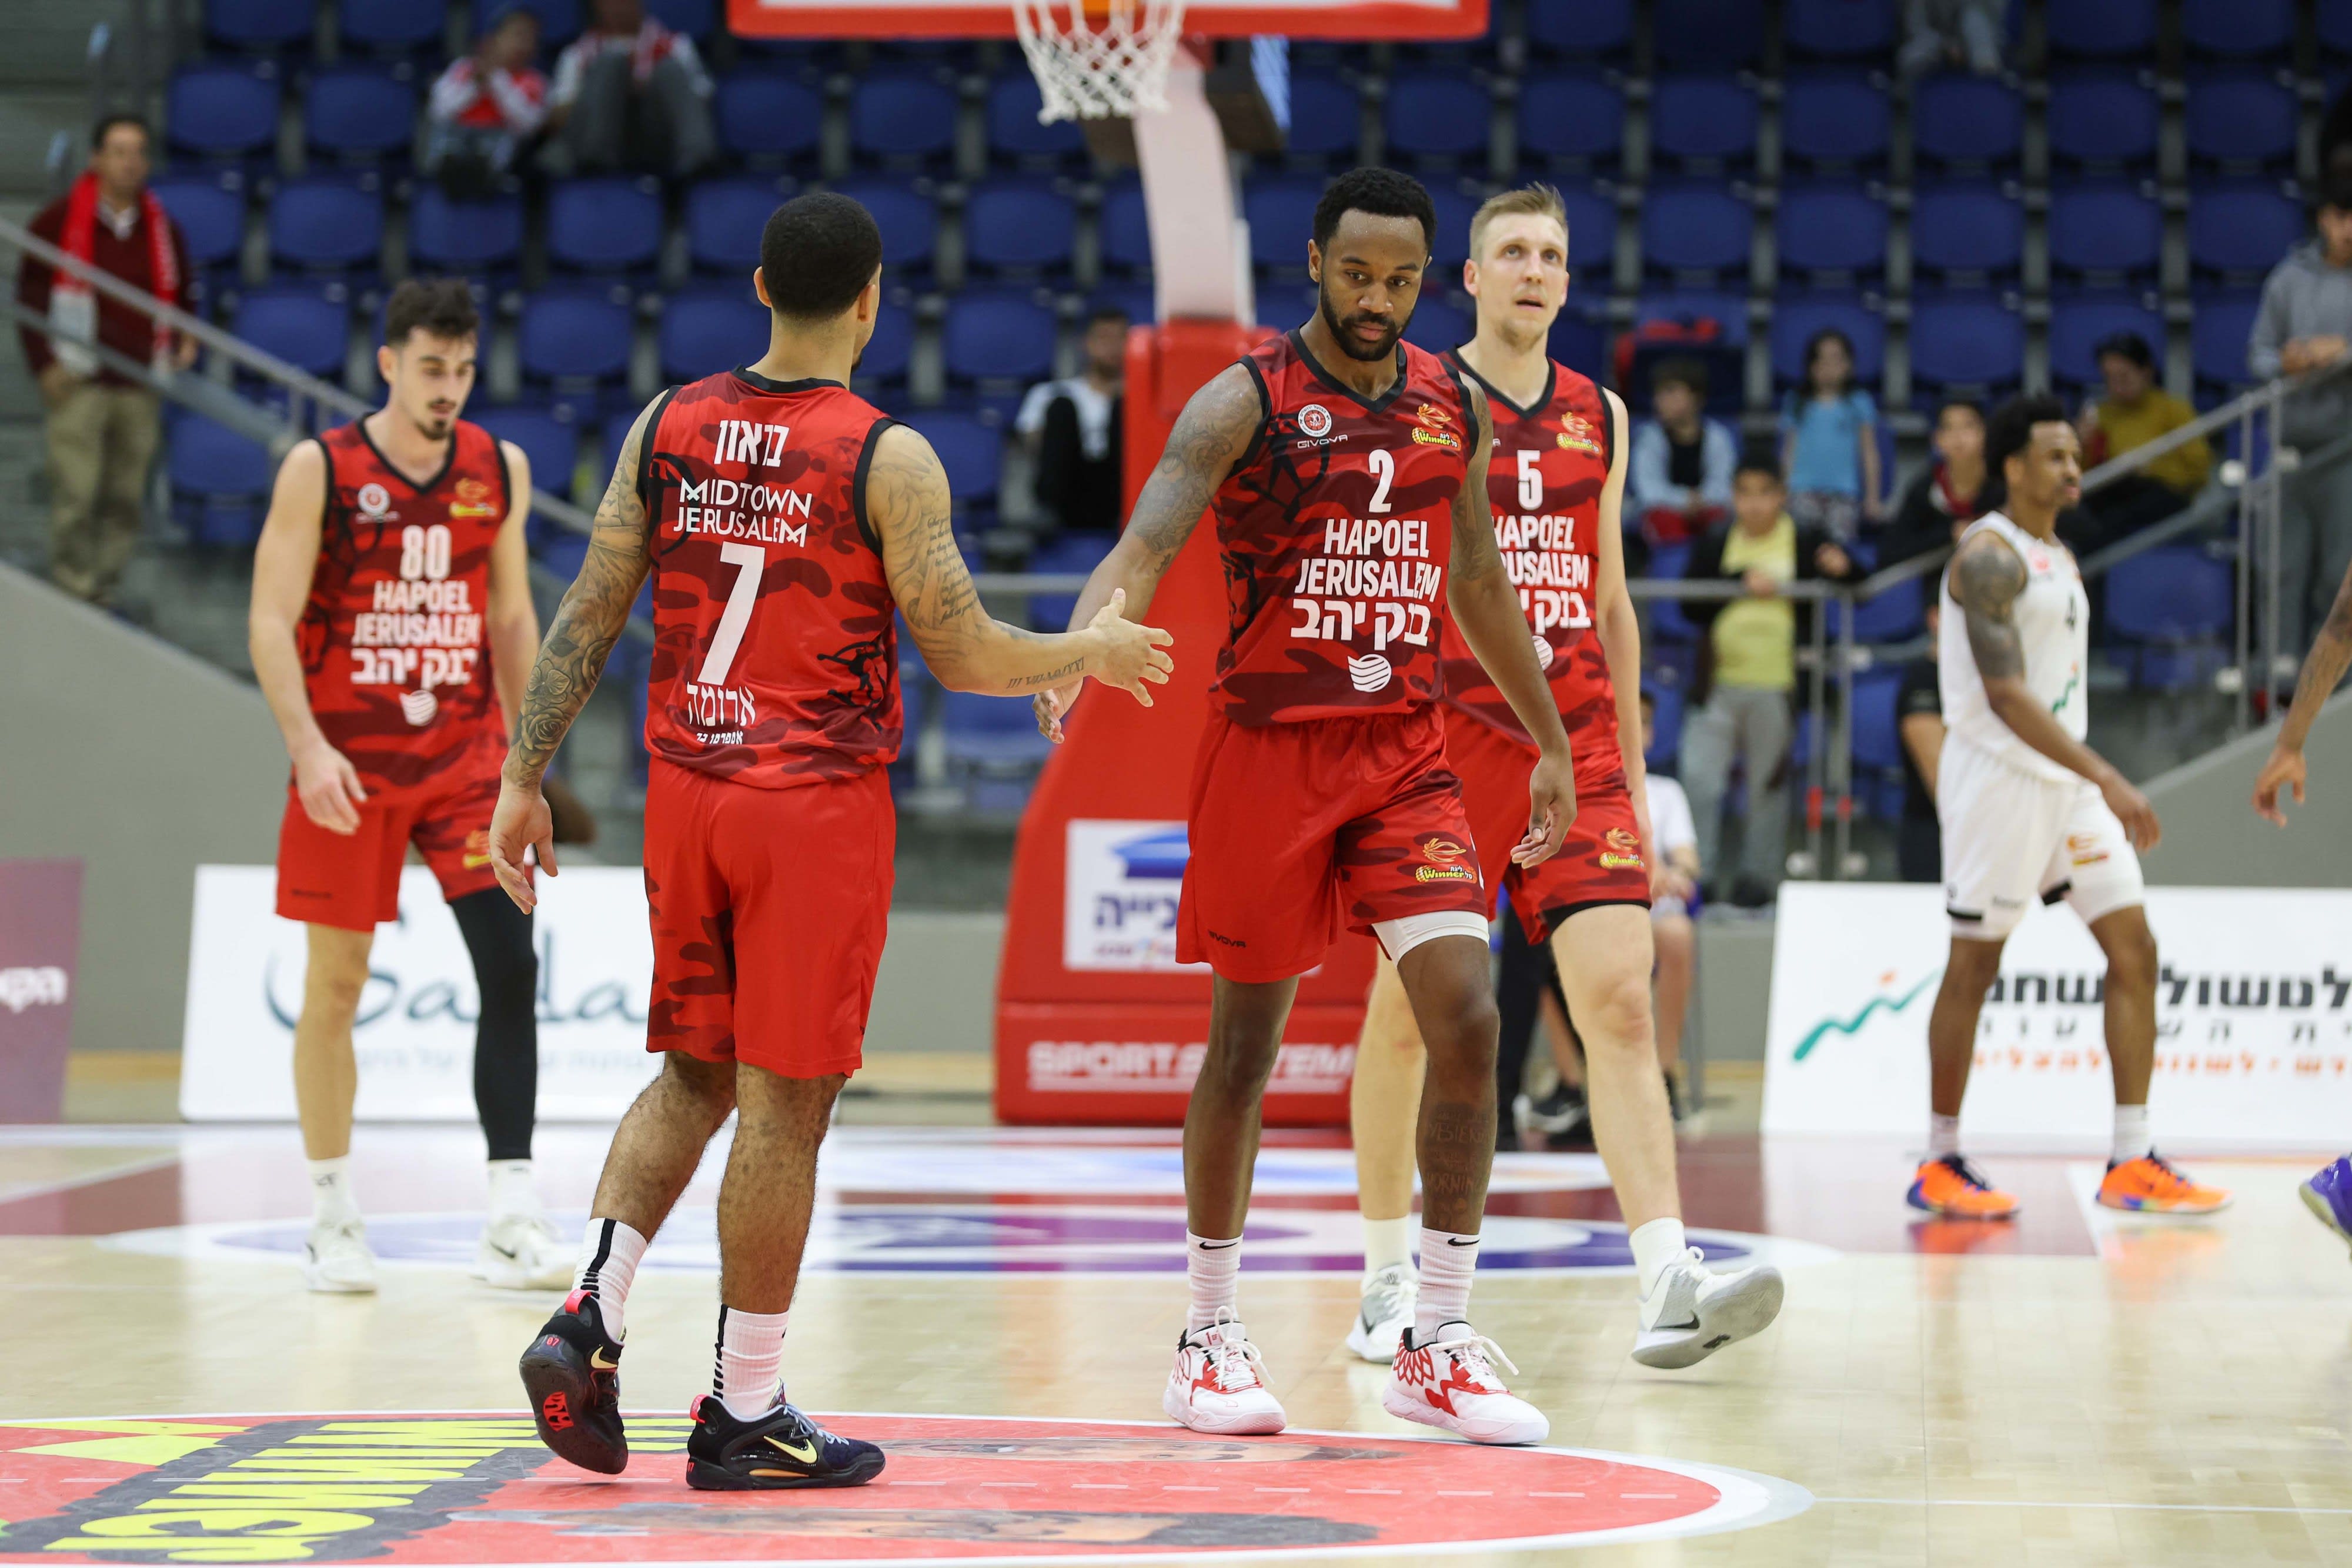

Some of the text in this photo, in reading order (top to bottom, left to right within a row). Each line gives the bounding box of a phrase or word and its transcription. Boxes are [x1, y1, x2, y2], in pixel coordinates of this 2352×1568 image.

[1297, 434, 1348, 449] GIVOVA
[1419, 432, 1451, 446] Winner
[680, 477, 813, 519] MIDTOWN
[1368, 449, 1395, 513] 2
[1516, 450, 1543, 510] 5
[673, 507, 808, 548] JERUSALEM
[1324, 519, 1429, 558] HAPOEL
[400, 524, 452, 580] 80
[1500, 551, 1589, 590] USALEM
[373, 580, 472, 613] HAPOEL
[1294, 559, 1441, 603] JERUSALEM
[352, 613, 481, 647] JERUSALEM
[697, 541, 765, 686] 7
[1291, 599, 1367, 641] יהב
[350, 648, 417, 684] יהב
[687, 681, 756, 727] ארומה
[1424, 869, 1464, 879] Winner
